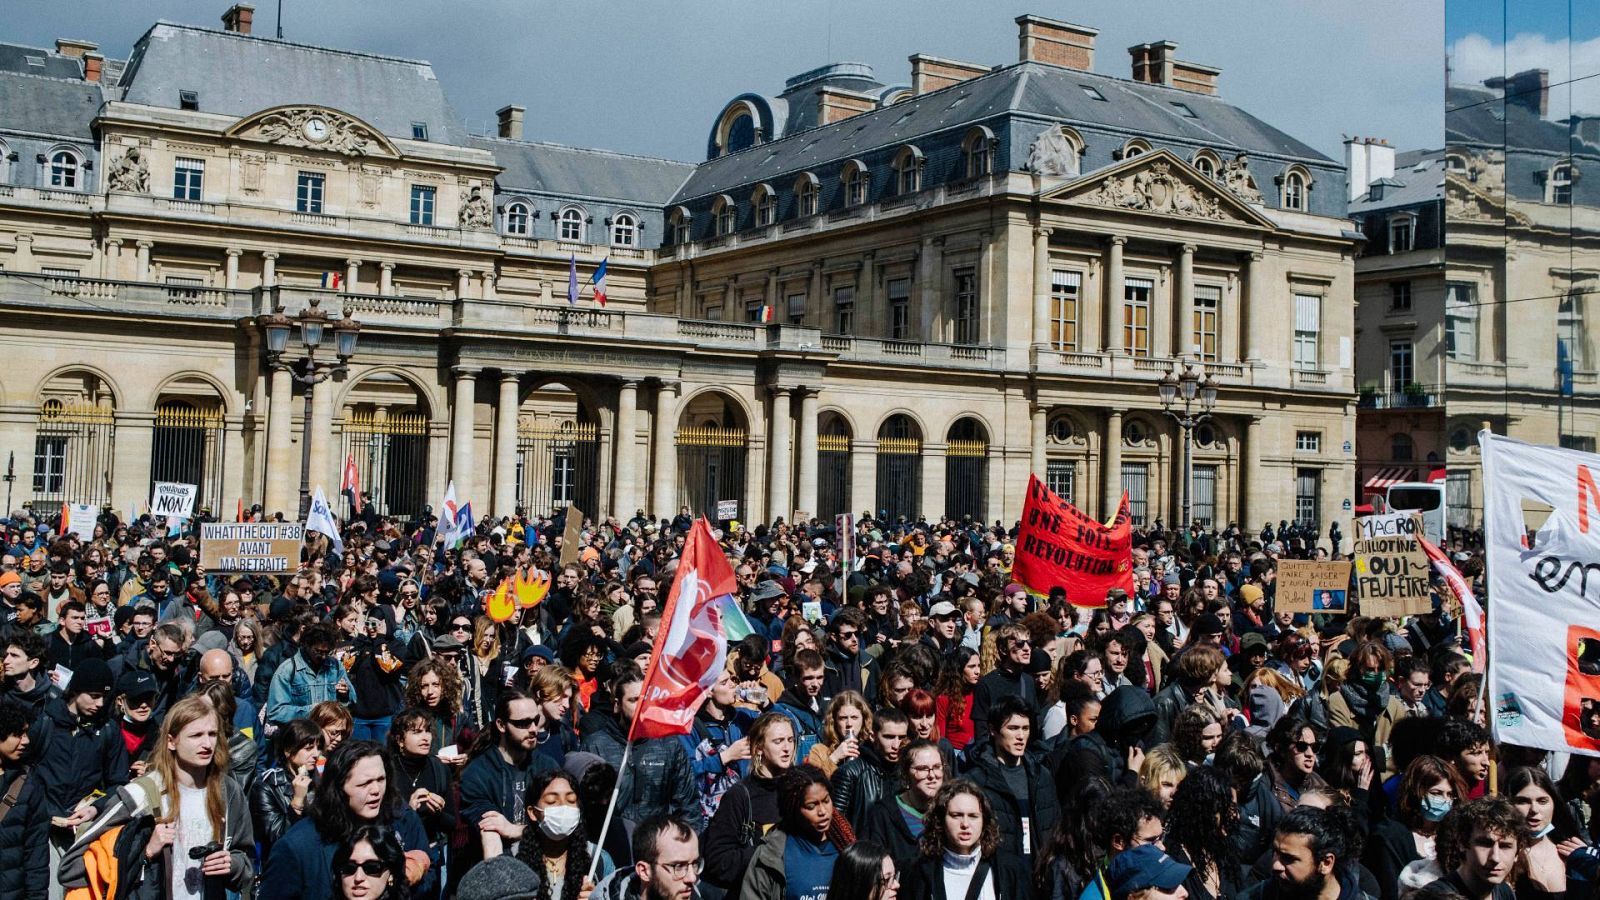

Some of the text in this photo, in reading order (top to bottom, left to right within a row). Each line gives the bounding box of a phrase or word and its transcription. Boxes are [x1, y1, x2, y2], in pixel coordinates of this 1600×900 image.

[1028, 508, 1062, 535] UNE
[1356, 517, 1425, 539] MACRON
[204, 526, 300, 540] WHAT THE CUT #38
[240, 542, 270, 555] AVANT
[220, 558, 287, 572] MA RETRAITE
